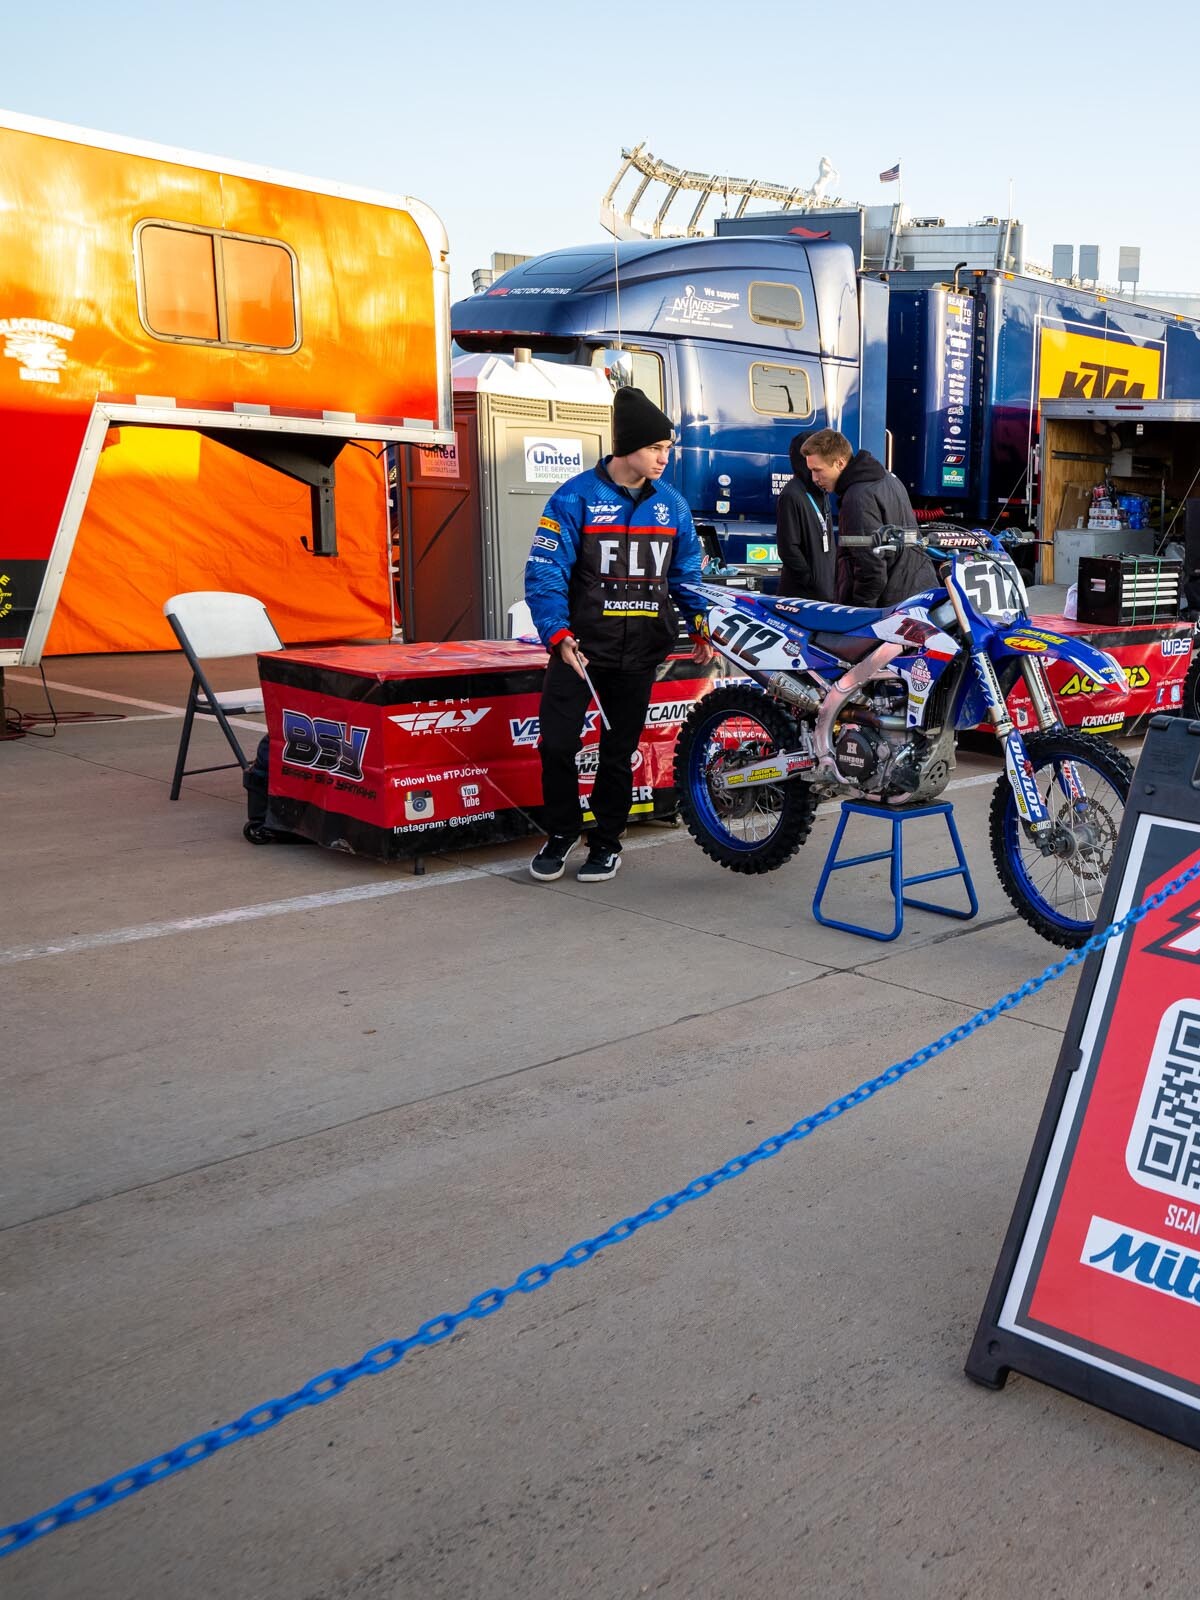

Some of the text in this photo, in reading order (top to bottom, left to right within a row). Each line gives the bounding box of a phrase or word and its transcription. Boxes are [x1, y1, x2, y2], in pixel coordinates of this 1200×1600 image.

[704, 288, 739, 300] We support
[1058, 362, 1145, 399] KTM
[534, 451, 580, 466] United
[940, 538, 988, 546] RENTHAL
[600, 540, 670, 576] FLY
[695, 587, 724, 598] DUNLOP
[964, 564, 1020, 614] 512
[604, 600, 659, 611] KÄRCHER
[712, 614, 783, 666] 512
[1006, 638, 1047, 650] FMF
[1162, 638, 1191, 657] WPS
[413, 698, 469, 707] TEAM
[388, 707, 492, 731] FLY
[1082, 712, 1125, 727] KÄRCHER
[411, 727, 472, 736] RACING
[282, 709, 371, 782] BSY
[394, 768, 488, 788] Follow the #TPJCrew
[1010, 740, 1042, 817] DUNLOP
[463, 786, 476, 796] You
[464, 796, 480, 808] Tube
[394, 811, 495, 834] Instagram: @tpjracing
